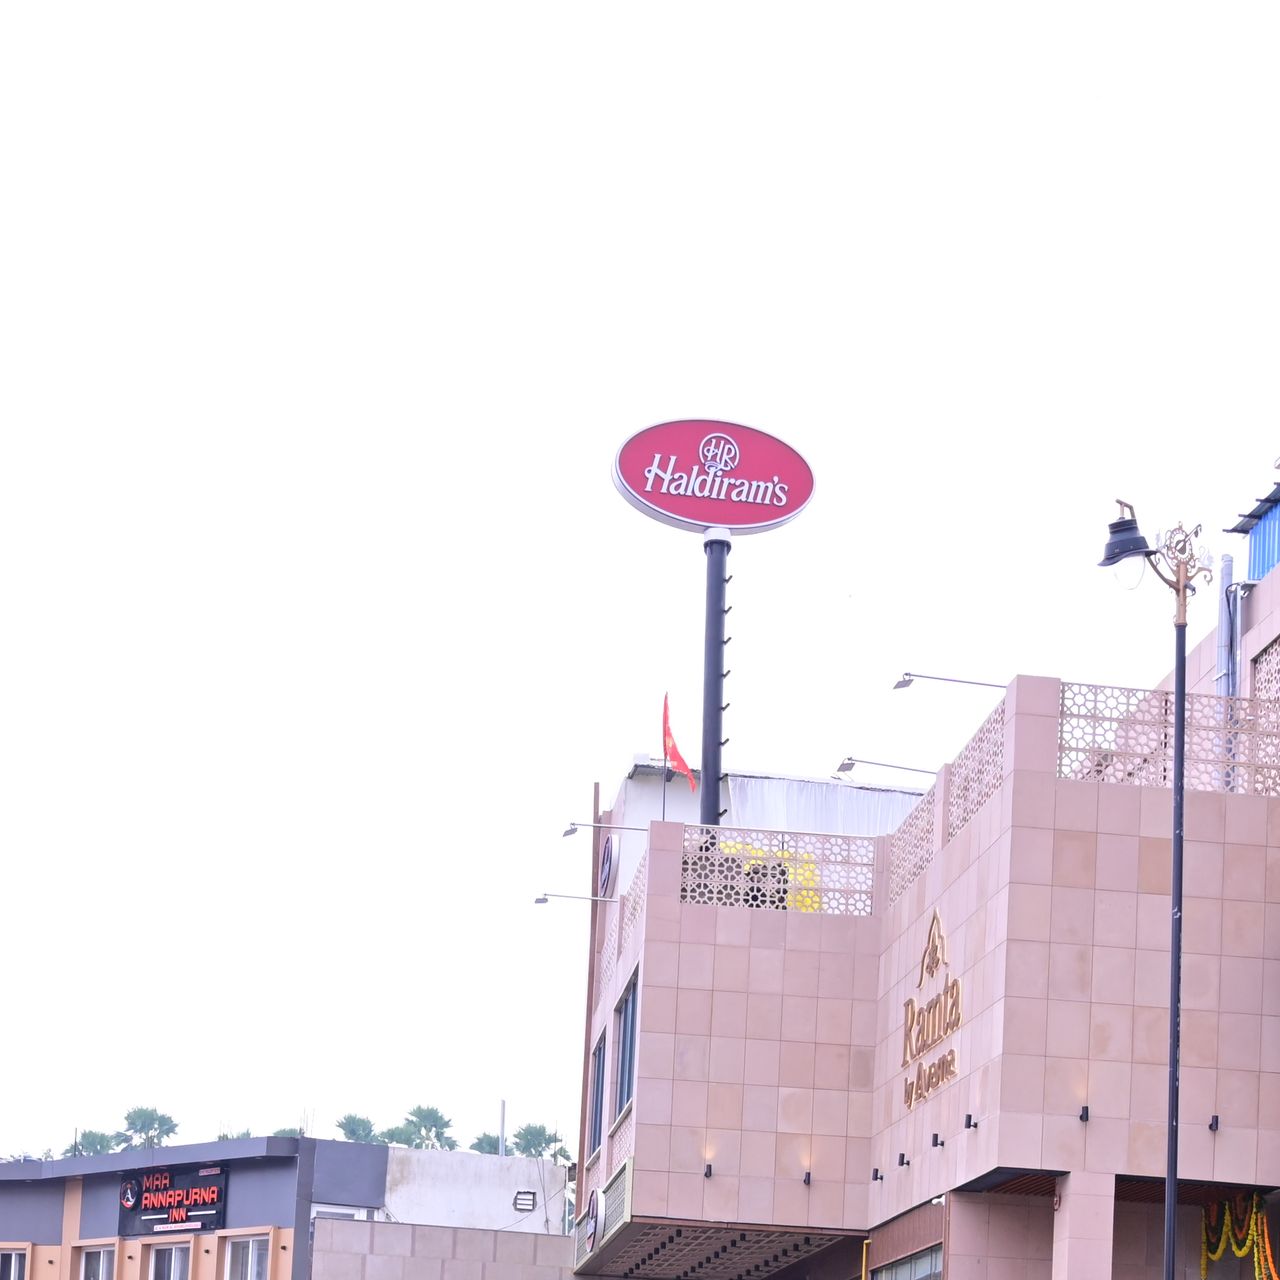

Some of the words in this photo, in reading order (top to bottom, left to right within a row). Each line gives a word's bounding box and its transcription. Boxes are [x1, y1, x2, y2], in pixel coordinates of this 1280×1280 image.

[644, 453, 788, 507] Haldiram's
[901, 972, 962, 1068] Ramta
[143, 1172, 170, 1190] MAA
[141, 1186, 218, 1209] ANNAPURNA
[168, 1208, 186, 1222] INN
